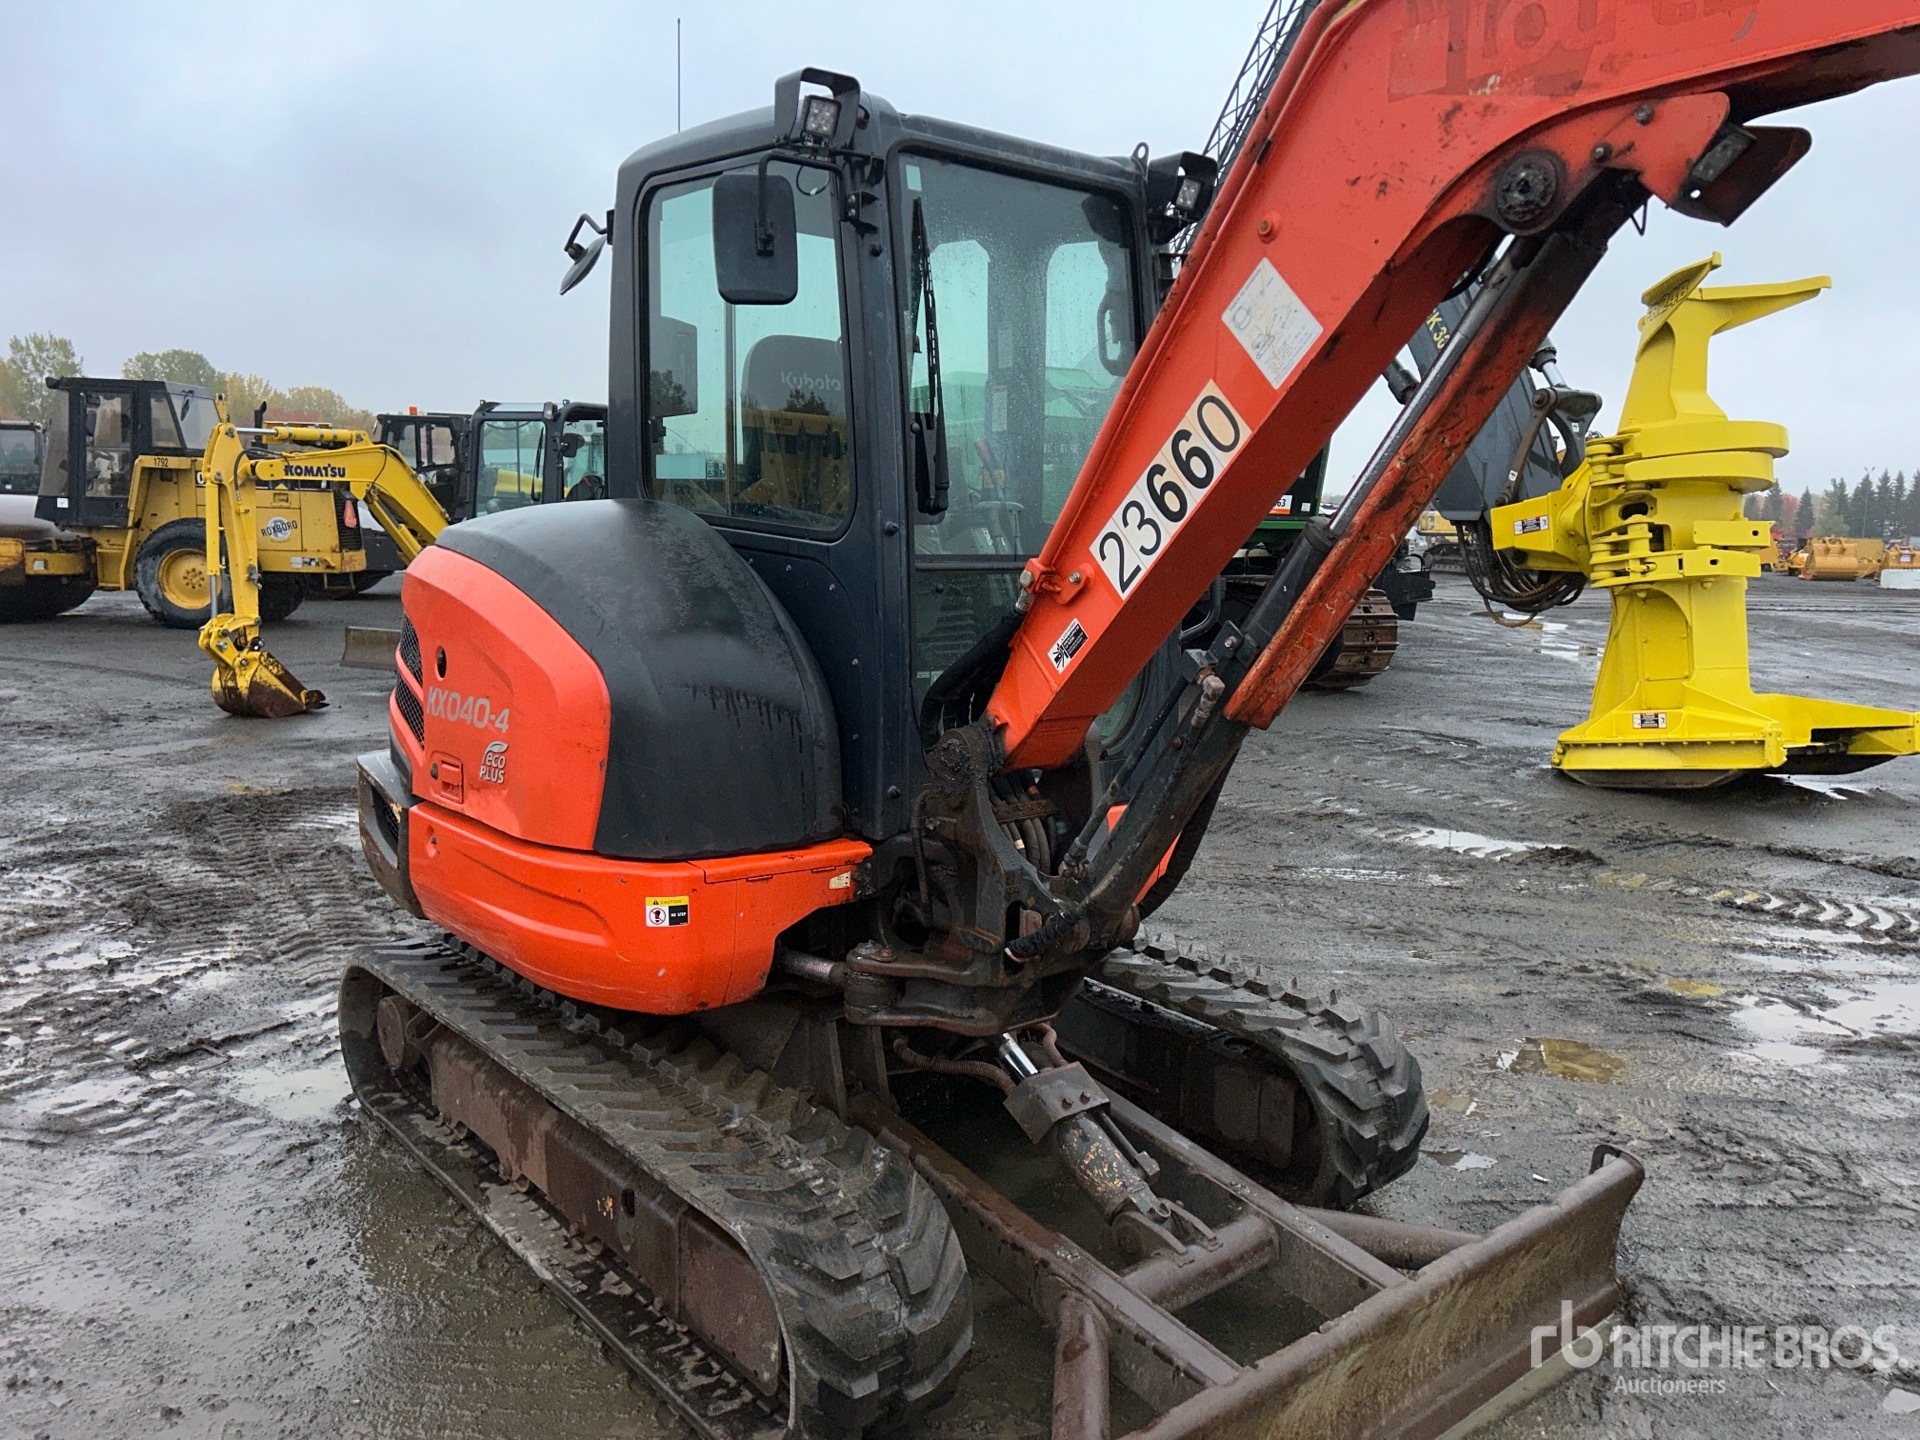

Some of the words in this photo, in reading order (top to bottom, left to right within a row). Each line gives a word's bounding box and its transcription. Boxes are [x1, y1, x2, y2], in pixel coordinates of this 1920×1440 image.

[780, 371, 842, 391] Kubota
[153, 457, 169, 468] 1792
[283, 463, 346, 478] KOMATSU
[1098, 395, 1241, 594] 23660
[261, 519, 298, 537] ROXBORO
[426, 686, 510, 733] KX040-4
[486, 751, 506, 769] eco
[479, 765, 505, 784] PLUS
